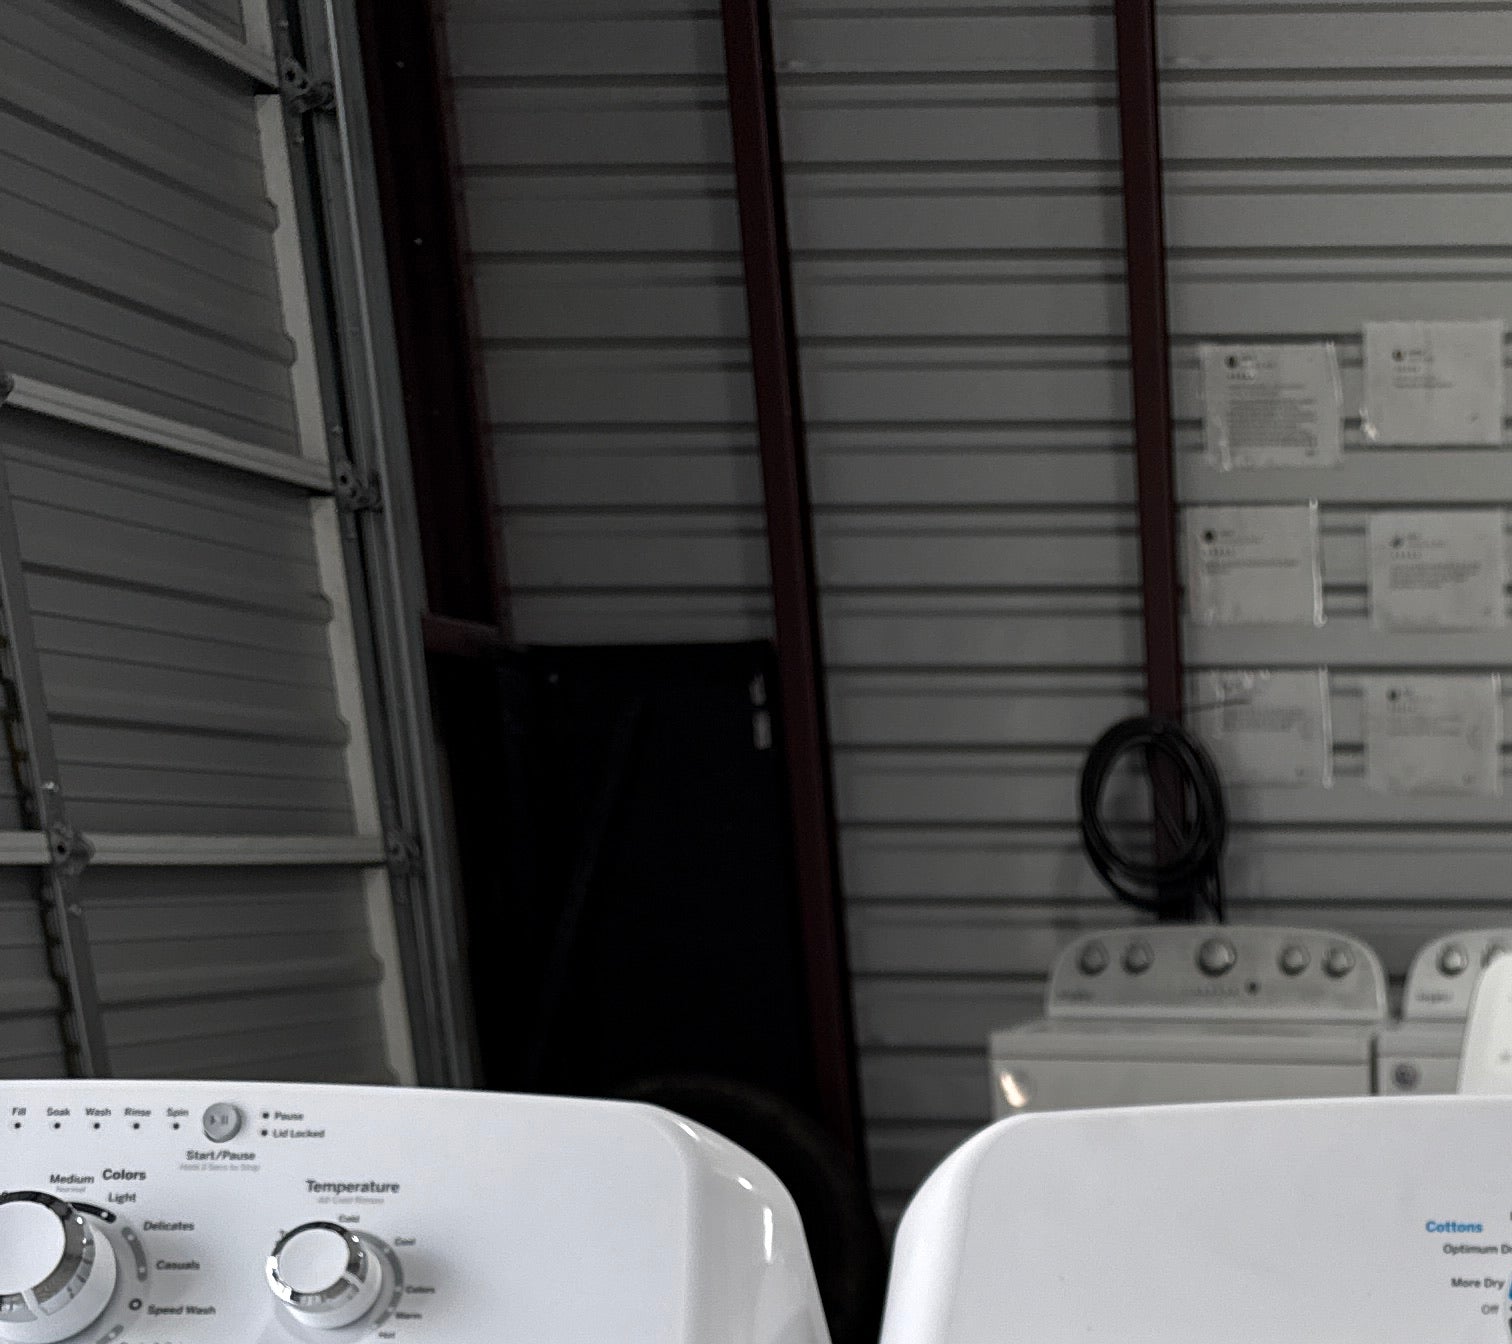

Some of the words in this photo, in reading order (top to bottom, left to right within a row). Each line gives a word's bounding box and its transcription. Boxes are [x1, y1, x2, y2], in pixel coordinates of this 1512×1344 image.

[12, 1107, 26, 1116] Fill
[47, 1107, 70, 1116] Soak
[86, 1108, 111, 1116] Wash
[124, 1108, 151, 1116] Rinse
[167, 1108, 189, 1117] Spin
[274, 1111, 304, 1120] Pause
[273, 1129, 289, 1138] Lid
[290, 1129, 325, 1138] Locked
[186, 1150, 256, 1161] Start/Pause
[50, 1174, 95, 1184] Medium
[102, 1169, 147, 1181] Colors
[306, 1180, 400, 1194] Temperature
[108, 1193, 136, 1204] Light
[143, 1221, 195, 1231] Delicates
[1425, 1220, 1483, 1233] Cottons
[1442, 1243, 1498, 1255] Optimum
[156, 1260, 200, 1270] Casuals
[1450, 1277, 1480, 1288] More
[1483, 1278, 1506, 1290] Dry
[148, 1305, 184, 1316] Speed
[186, 1305, 216, 1315] Wash
[1480, 1304, 1499, 1315] Off
